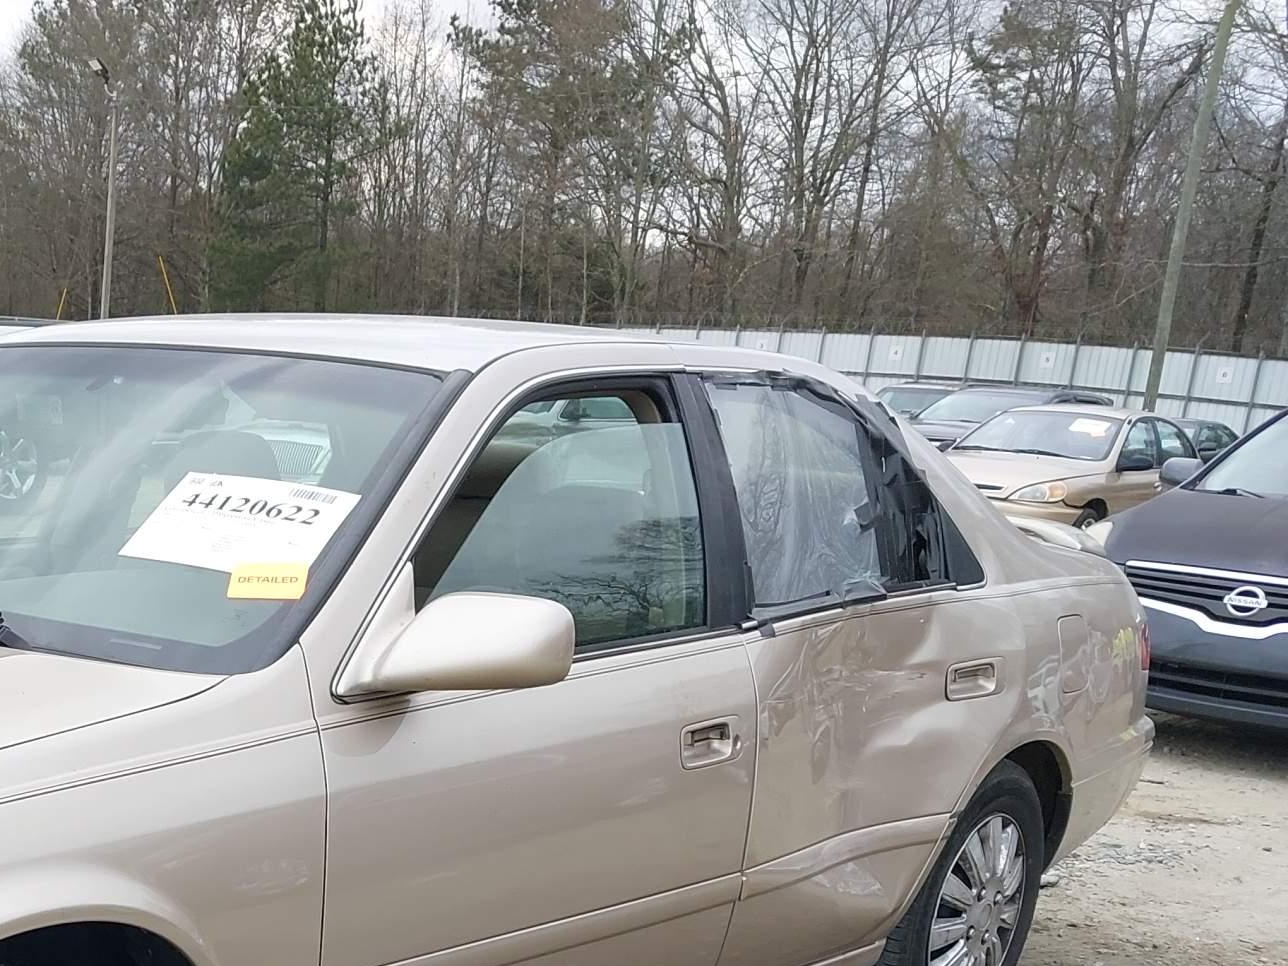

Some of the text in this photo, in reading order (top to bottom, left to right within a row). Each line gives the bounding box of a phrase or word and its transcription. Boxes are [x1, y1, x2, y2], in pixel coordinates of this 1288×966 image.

[181, 492, 321, 526] 44120622
[237, 575, 299, 585] DETAILED
[1226, 596, 1262, 606] NISSAN
